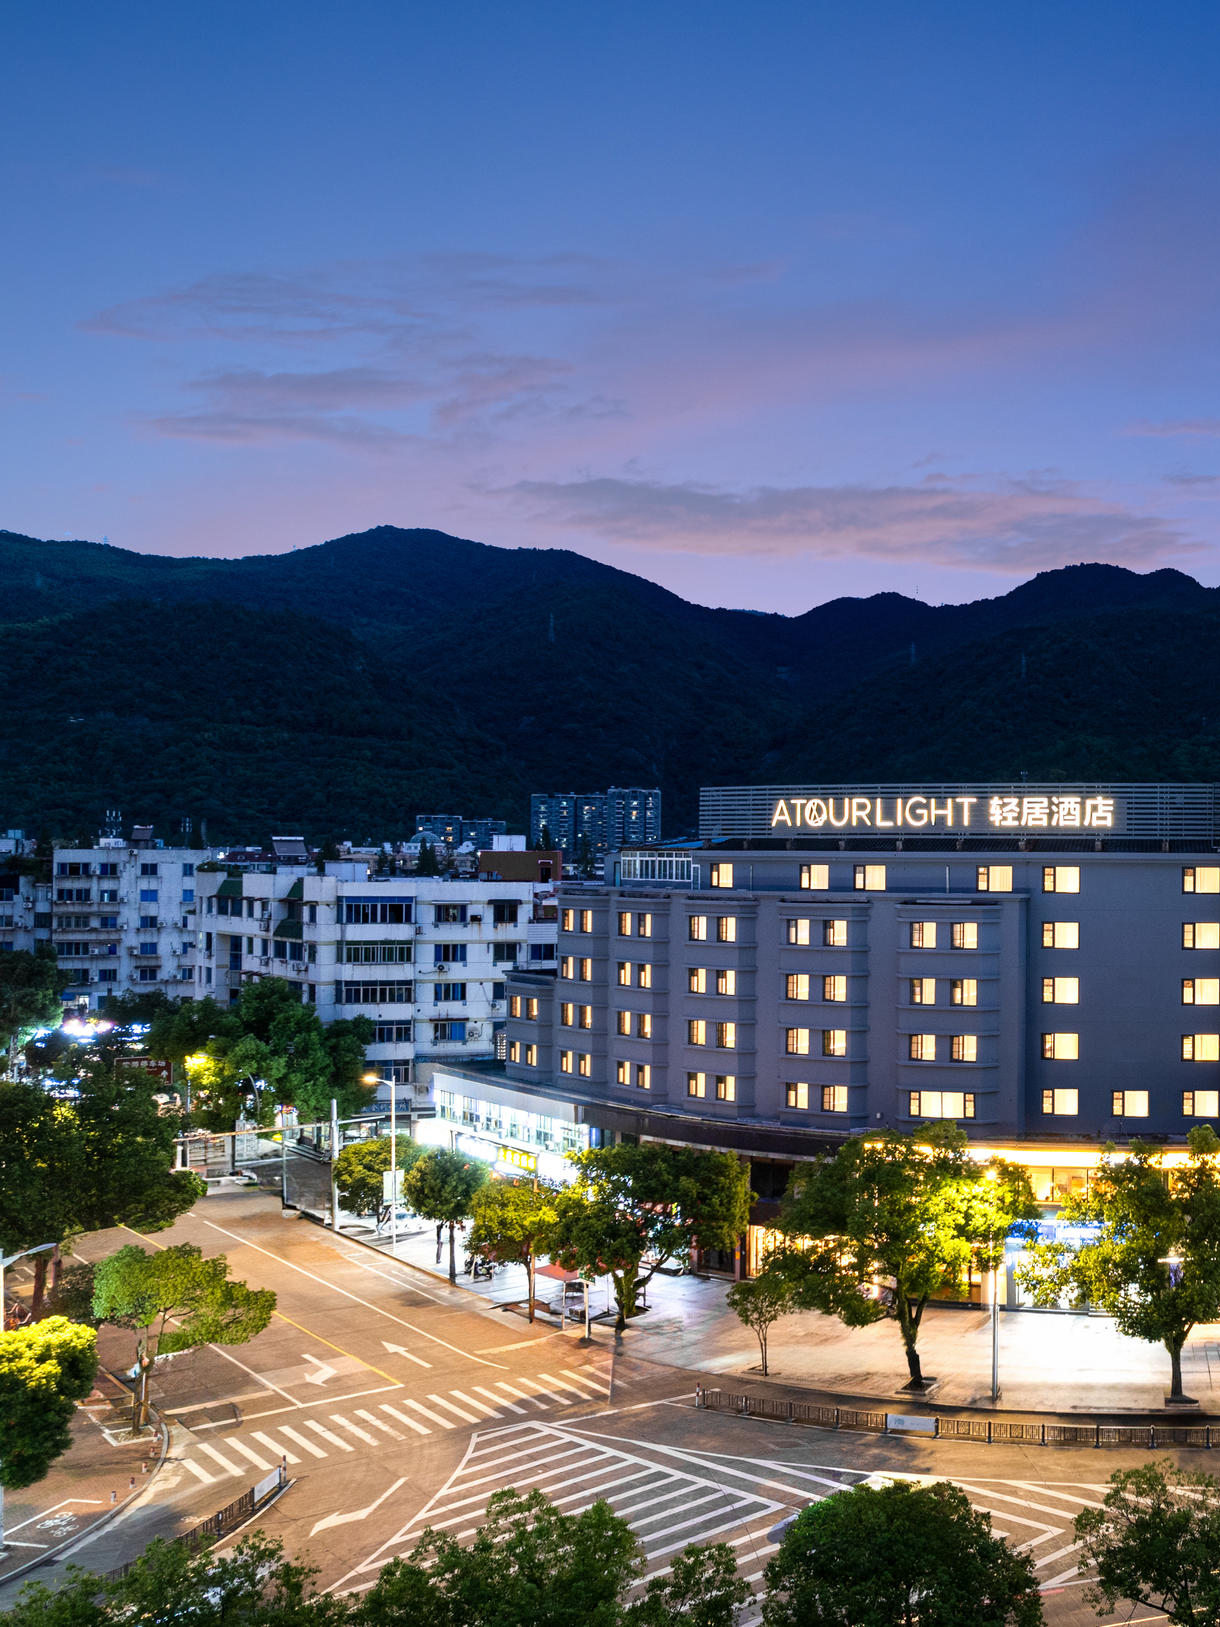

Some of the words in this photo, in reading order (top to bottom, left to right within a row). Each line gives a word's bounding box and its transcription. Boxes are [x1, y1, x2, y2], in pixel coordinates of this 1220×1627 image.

[771, 796, 977, 827] ATOURLIGHT
[989, 796, 1114, 827] 轻居酒店
